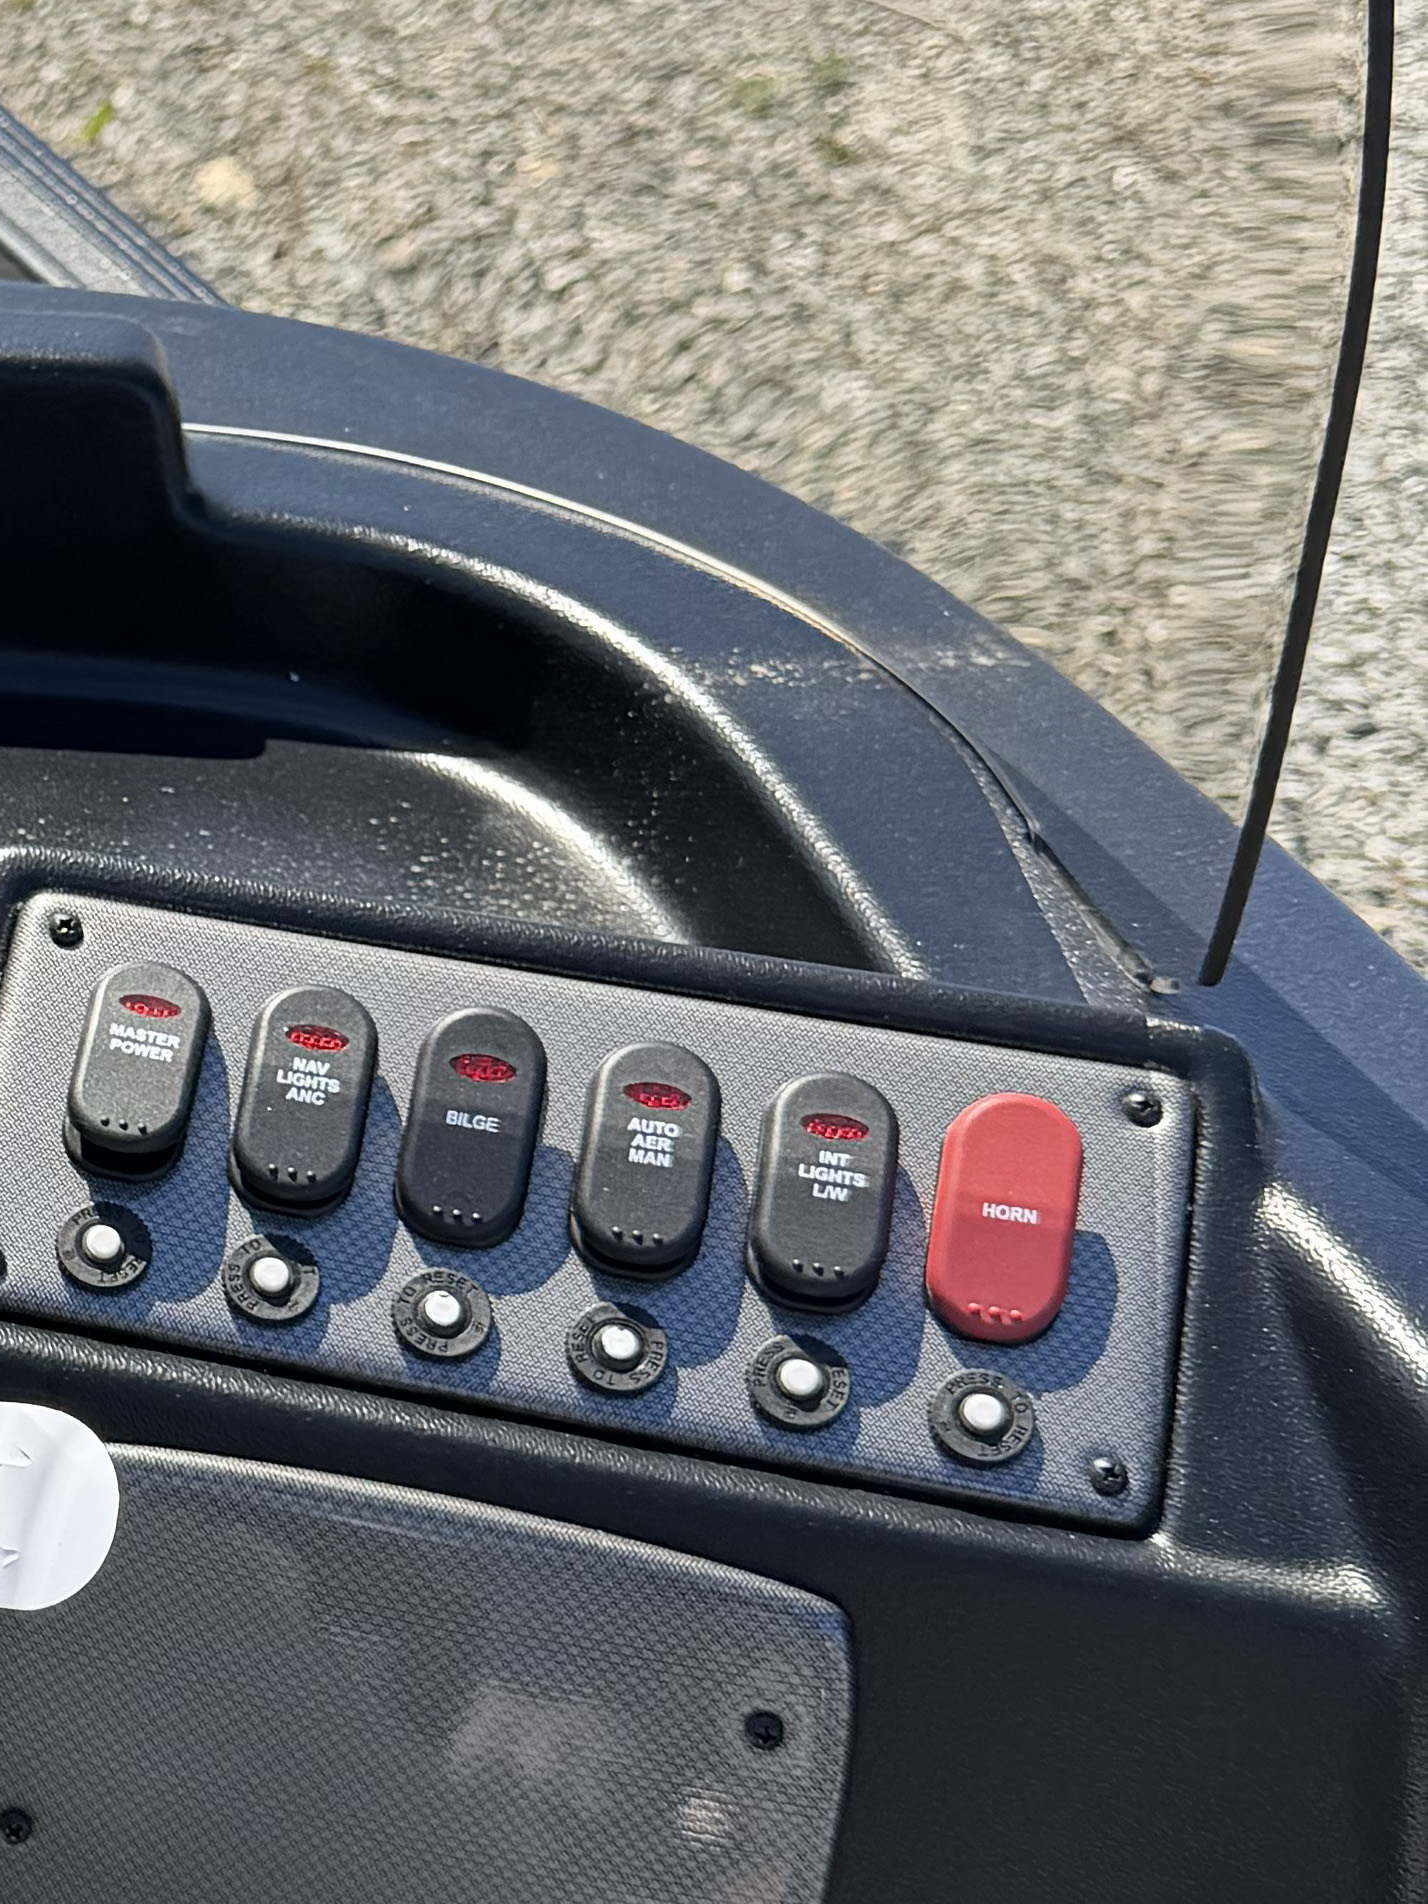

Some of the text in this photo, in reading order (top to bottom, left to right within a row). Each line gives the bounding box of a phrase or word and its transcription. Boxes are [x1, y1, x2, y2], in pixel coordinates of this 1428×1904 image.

[109, 1023, 181, 1049] MASTER
[109, 1037, 174, 1063] POWER
[292, 1057, 330, 1075] NAV
[276, 1069, 341, 1094] LIGHTS
[286, 1087, 326, 1106] ANC
[445, 1110, 500, 1133] BILGE
[627, 1117, 680, 1138] AUTO
[631, 1134, 673, 1153] AER
[628, 1148, 672, 1168] MAN
[818, 1150, 850, 1167] INT
[798, 1164, 866, 1188] LIGHTS
[982, 1203, 1039, 1225] HORN
[228, 1238, 262, 1311] PRESS TO
[396, 1270, 479, 1353] PRESS TO RESET
[629, 1340, 665, 1384] PRESS
[592, 1369, 615, 1386] TO
[752, 1340, 847, 1411] PRESS ESET
[944, 1371, 1003, 1395] PRESS
[977, 1424, 1029, 1457] RESET
